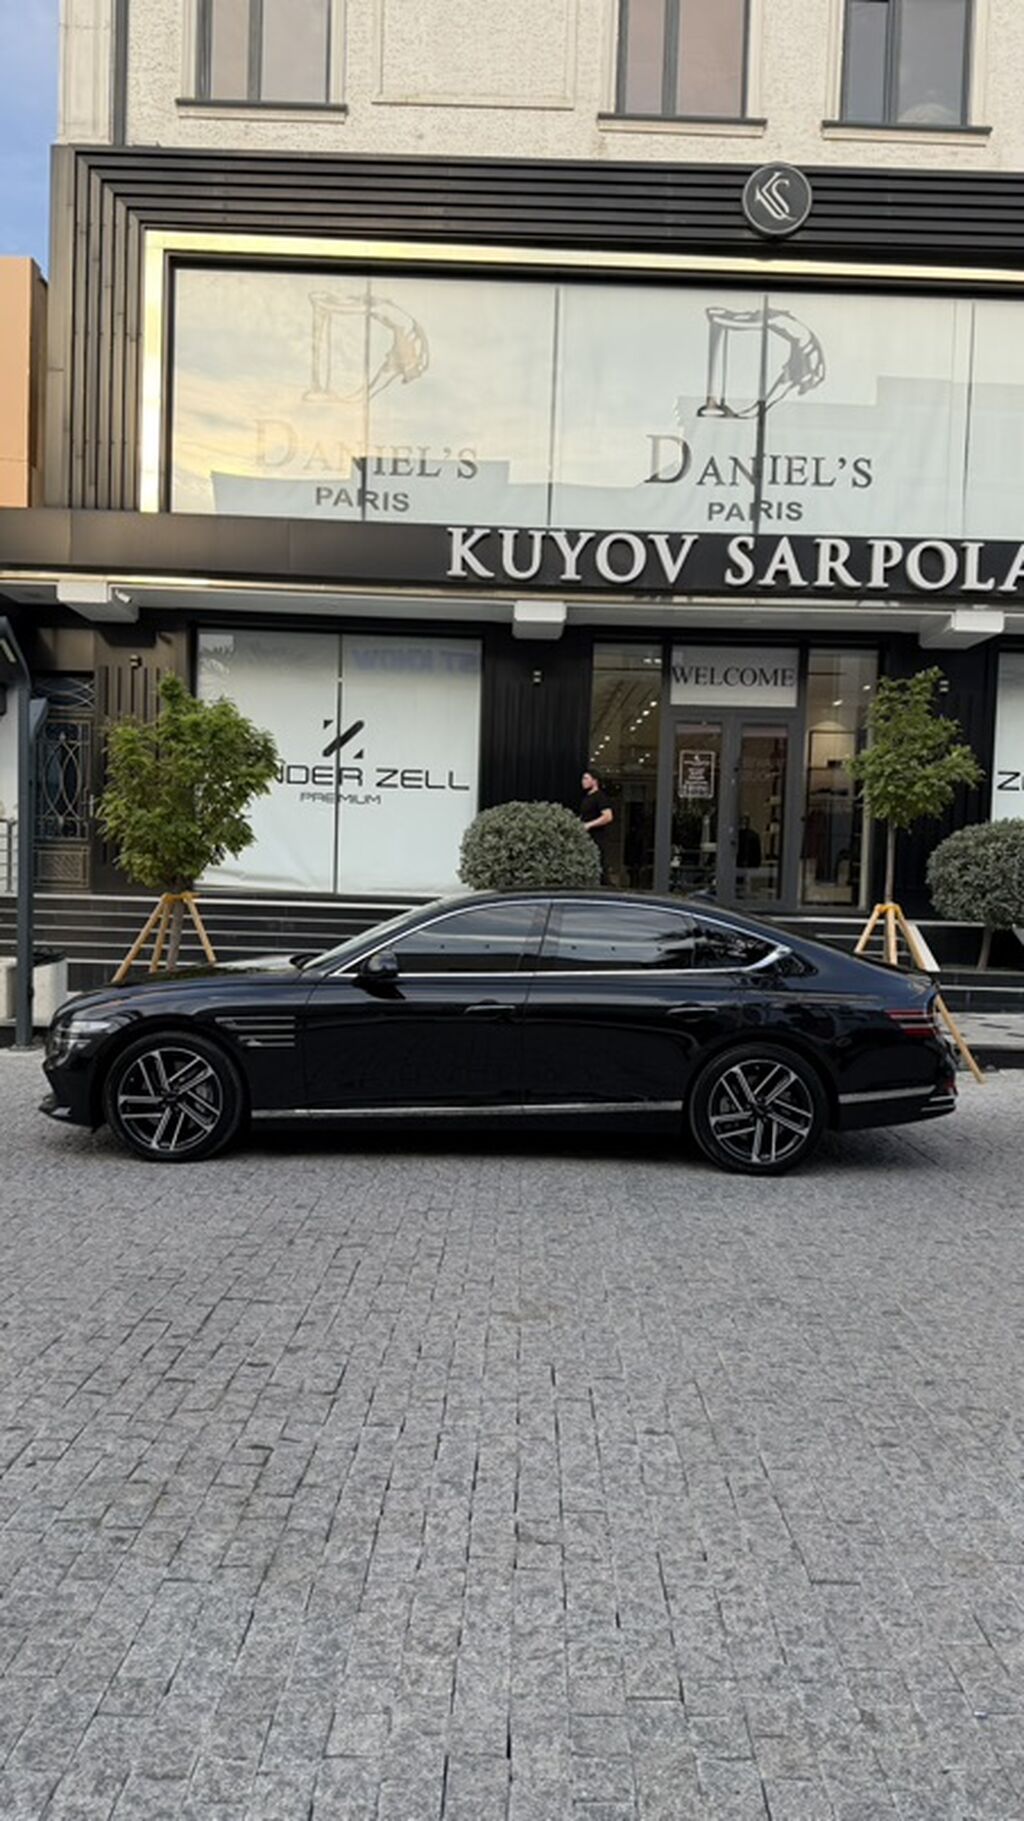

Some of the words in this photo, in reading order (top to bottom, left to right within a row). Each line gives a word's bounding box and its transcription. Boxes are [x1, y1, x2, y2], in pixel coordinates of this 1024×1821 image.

[254, 419, 478, 480] DANIEL'S
[644, 435, 873, 488] DANIEL'S
[315, 487, 410, 512] PARIS
[707, 500, 803, 522] PARIS
[446, 527, 699, 583] KUYOV
[671, 665, 797, 688] WELCOME
[375, 767, 470, 791] ZELL
[997, 771, 1024, 791] Z
[300, 792, 381, 804] PREMIUM
